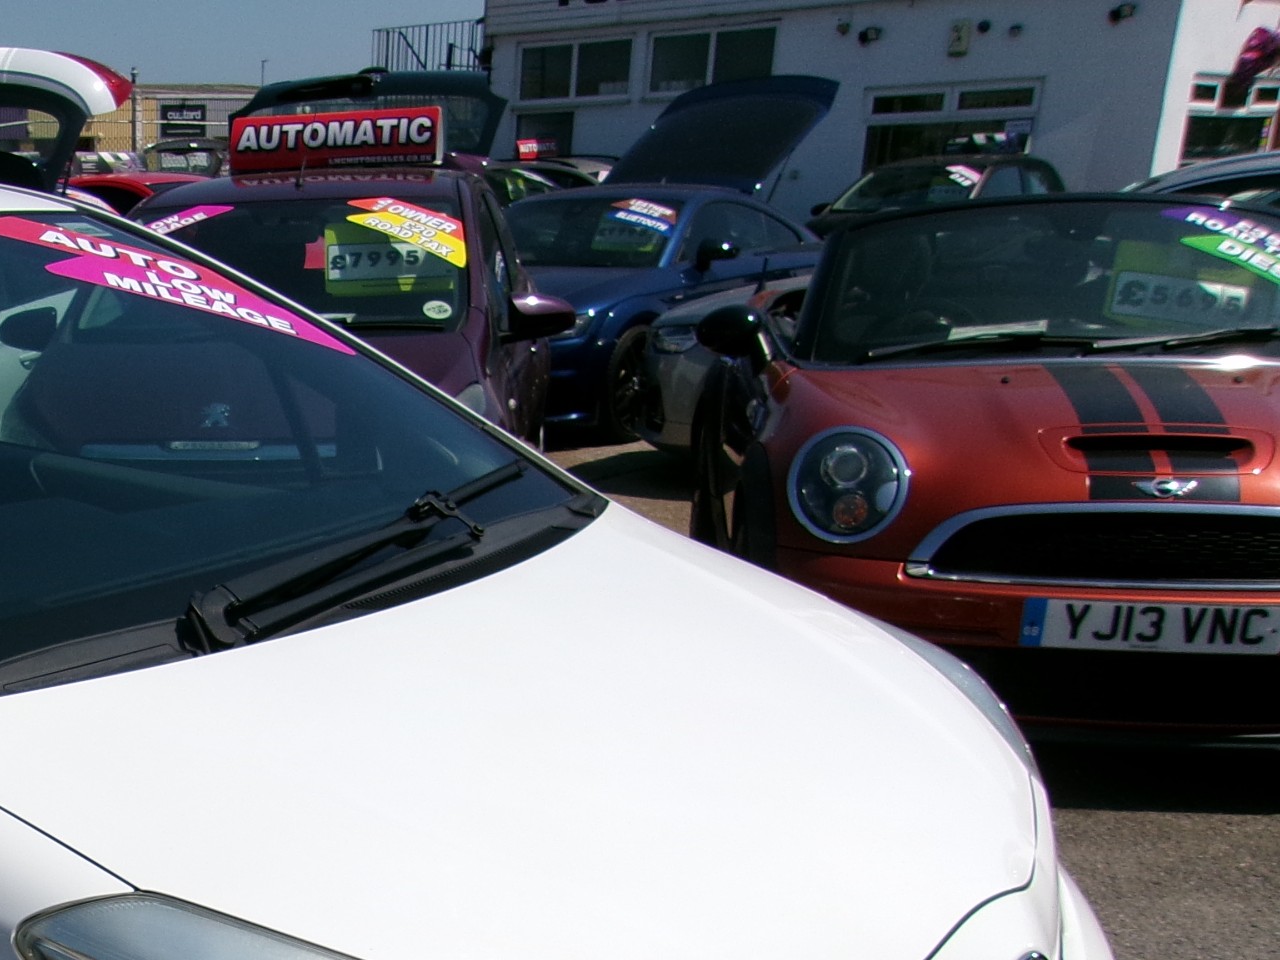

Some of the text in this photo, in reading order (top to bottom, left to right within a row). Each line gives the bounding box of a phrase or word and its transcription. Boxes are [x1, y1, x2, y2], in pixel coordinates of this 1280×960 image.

[236, 116, 434, 153] AUTOMATIC
[149, 214, 180, 230] OW
[155, 211, 209, 235] EAGE
[387, 203, 458, 234] OWNER
[400, 220, 436, 239] £20
[615, 211, 669, 232] BLUETOOTH
[1184, 212, 1260, 244] ROAD
[364, 216, 456, 258] ROAD TAX
[38, 229, 202, 281] AUTO
[330, 250, 420, 272] £7995
[144, 269, 237, 305] LOW
[103, 271, 298, 336] MILEAGE
[1065, 603, 1269, 645] YJ13 VNC
